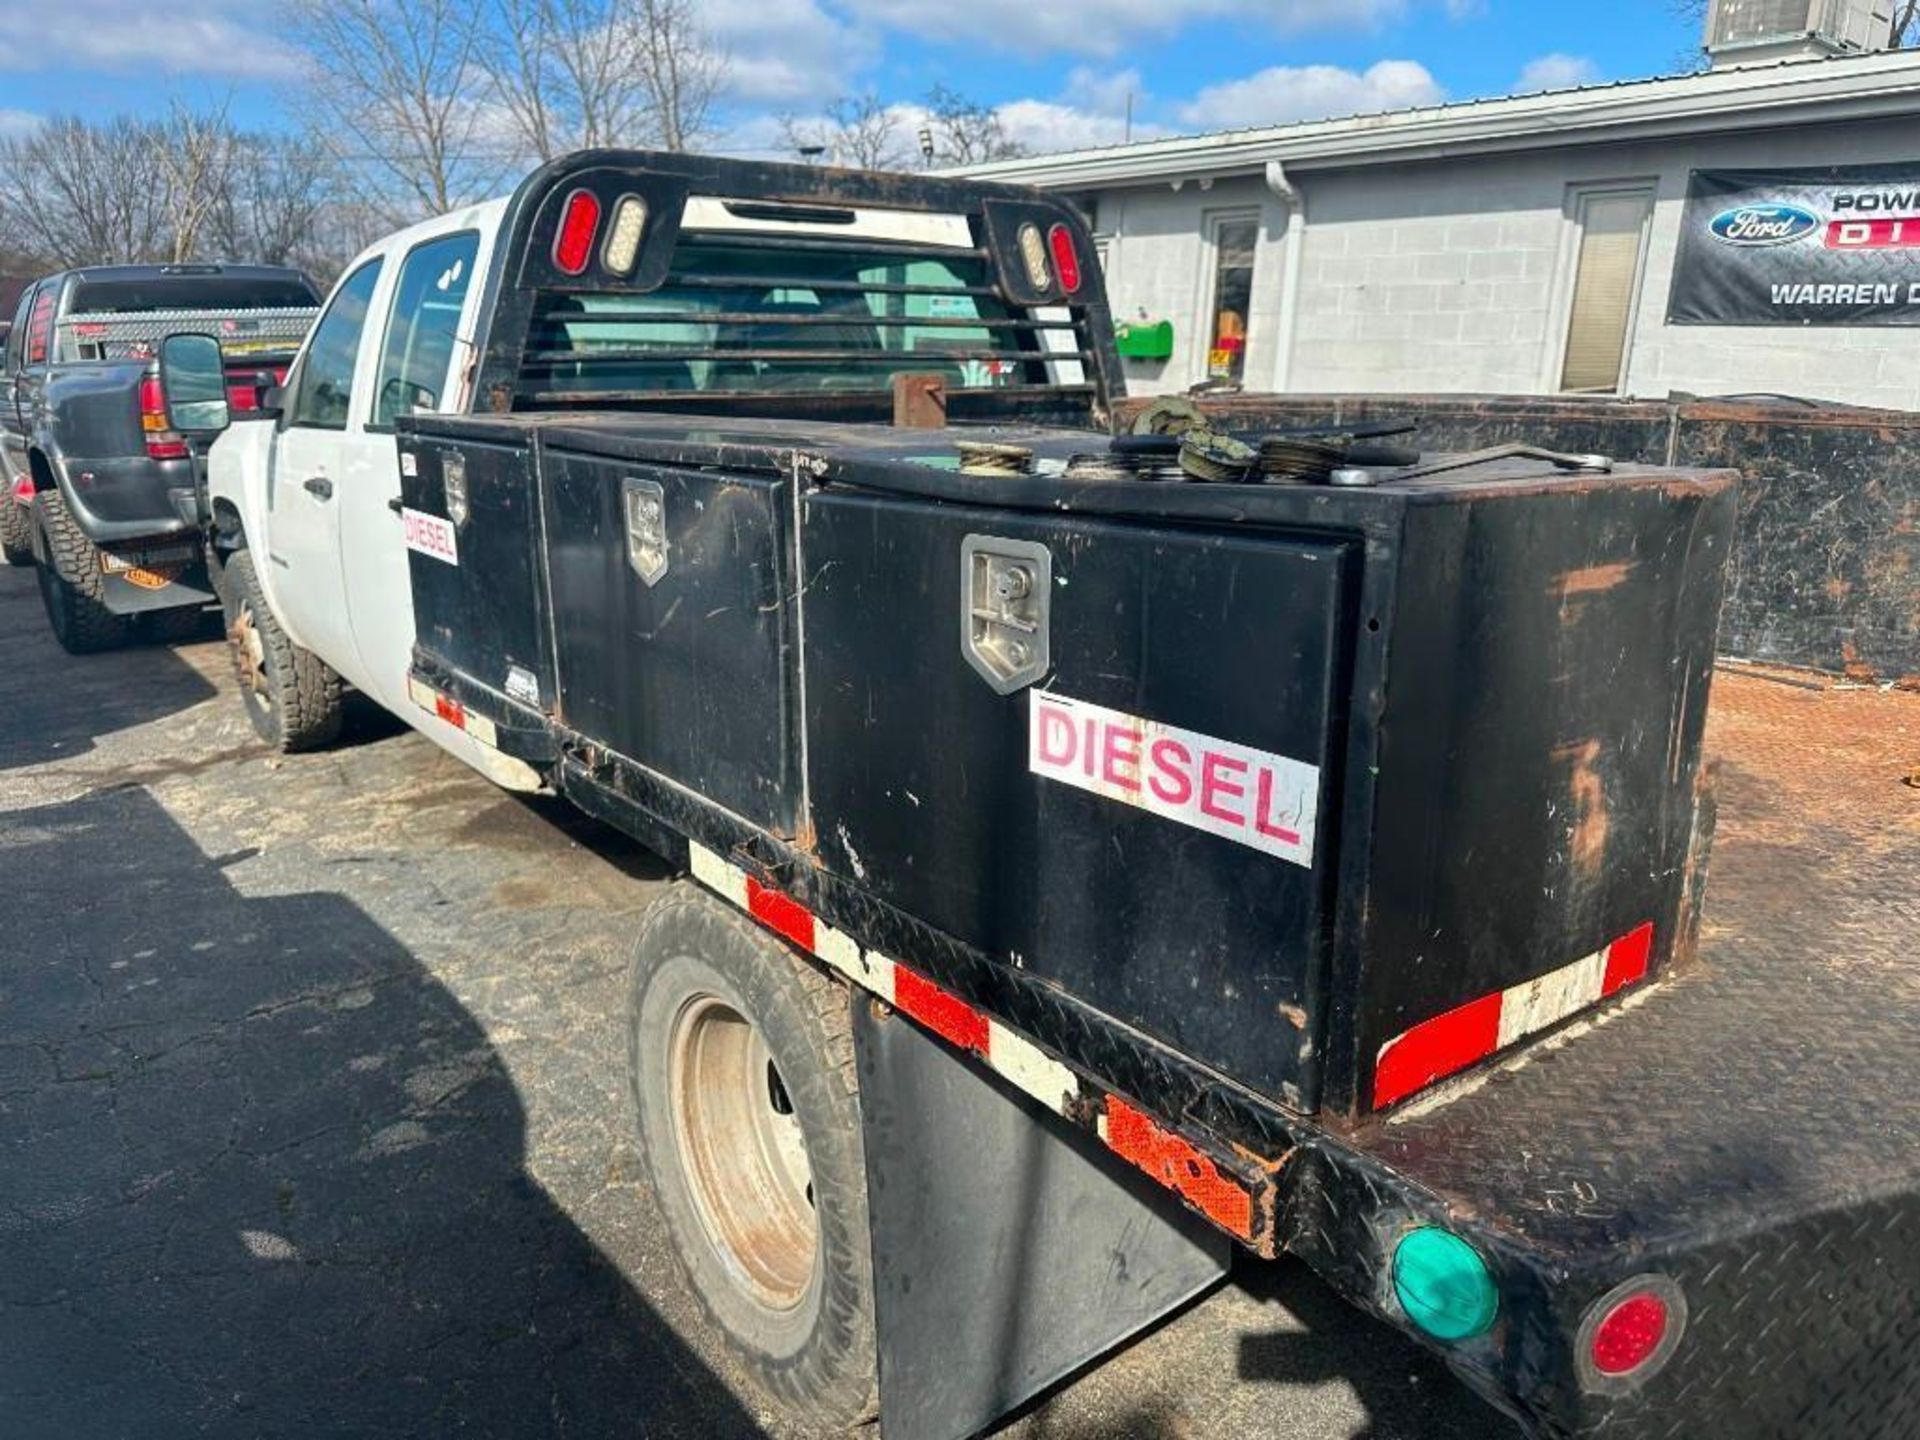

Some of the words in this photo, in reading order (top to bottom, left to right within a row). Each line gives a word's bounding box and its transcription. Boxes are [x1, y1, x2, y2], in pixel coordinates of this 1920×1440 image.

[1726, 208, 1796, 239] Ford
[1771, 283, 1898, 305] WARREN
[404, 514, 455, 557] DIESEL
[1038, 704, 1301, 846] DIESEL
